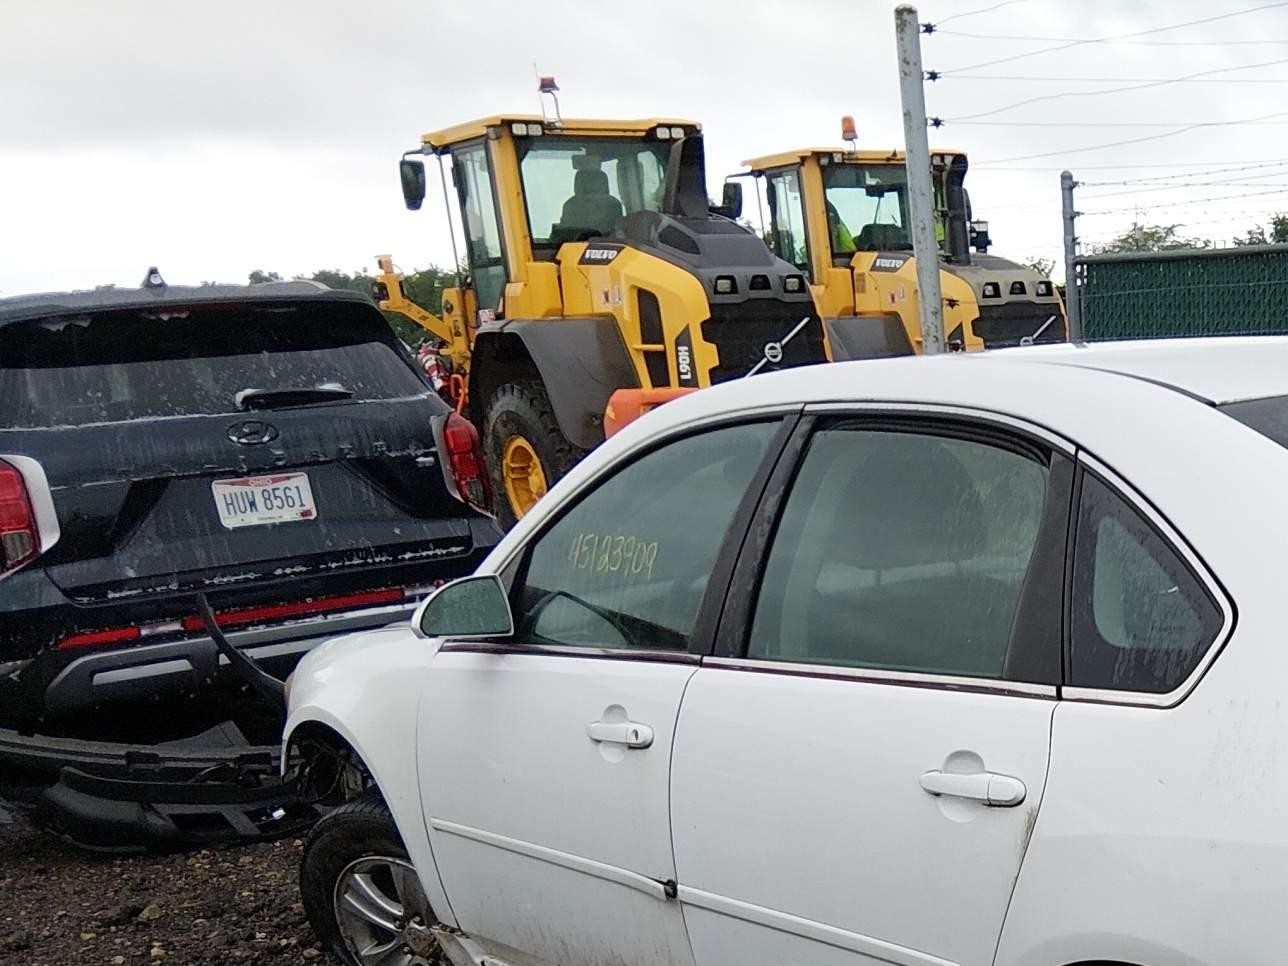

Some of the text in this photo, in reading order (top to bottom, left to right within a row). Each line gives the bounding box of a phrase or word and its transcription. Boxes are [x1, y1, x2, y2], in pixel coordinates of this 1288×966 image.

[677, 345, 692, 380] L90H
[223, 485, 306, 517] HUW 8561
[568, 533, 659, 581] 45123909
